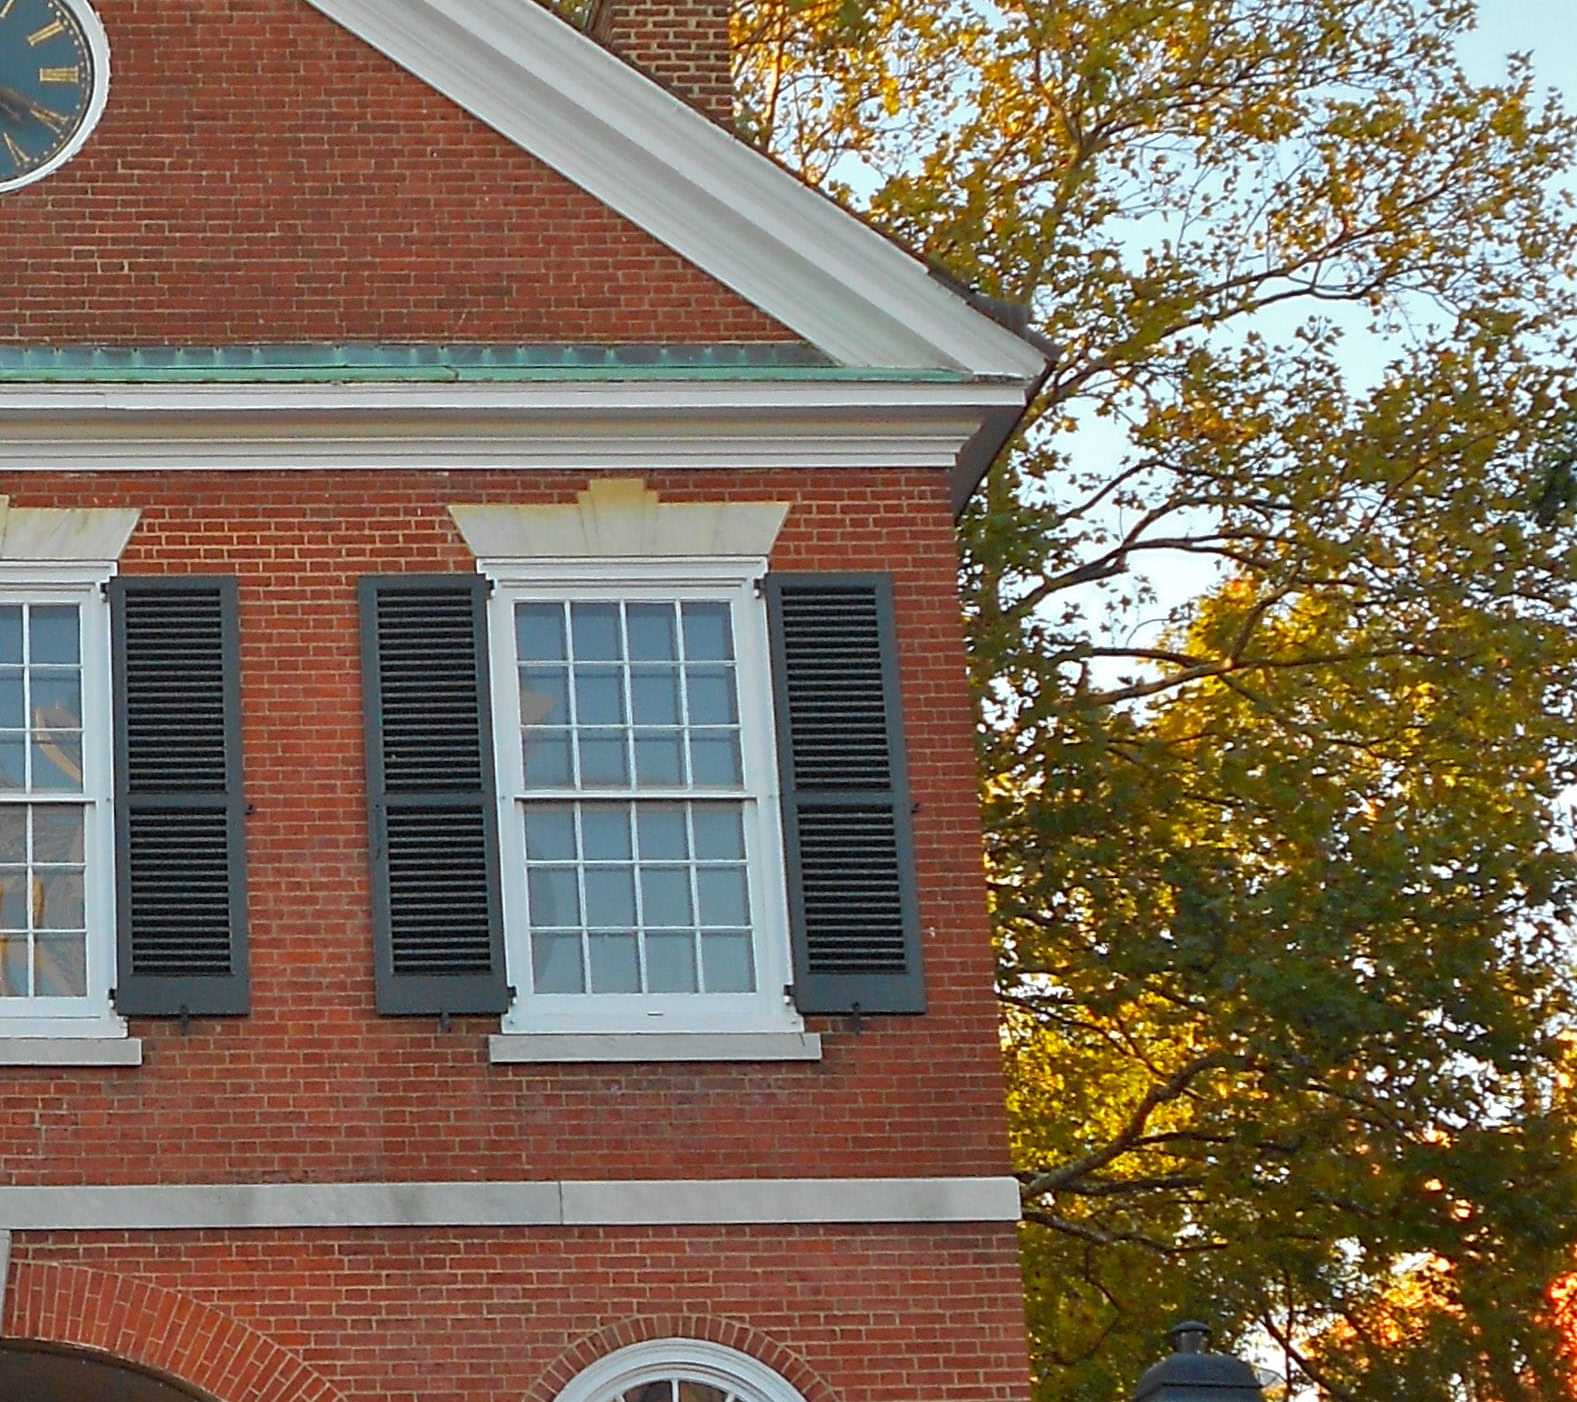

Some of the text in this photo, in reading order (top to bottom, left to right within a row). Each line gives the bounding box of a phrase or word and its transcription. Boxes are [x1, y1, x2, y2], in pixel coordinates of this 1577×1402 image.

[27, 20, 64, 47] II
[39, 66, 79, 83] III
[4, 131, 32, 166] V
